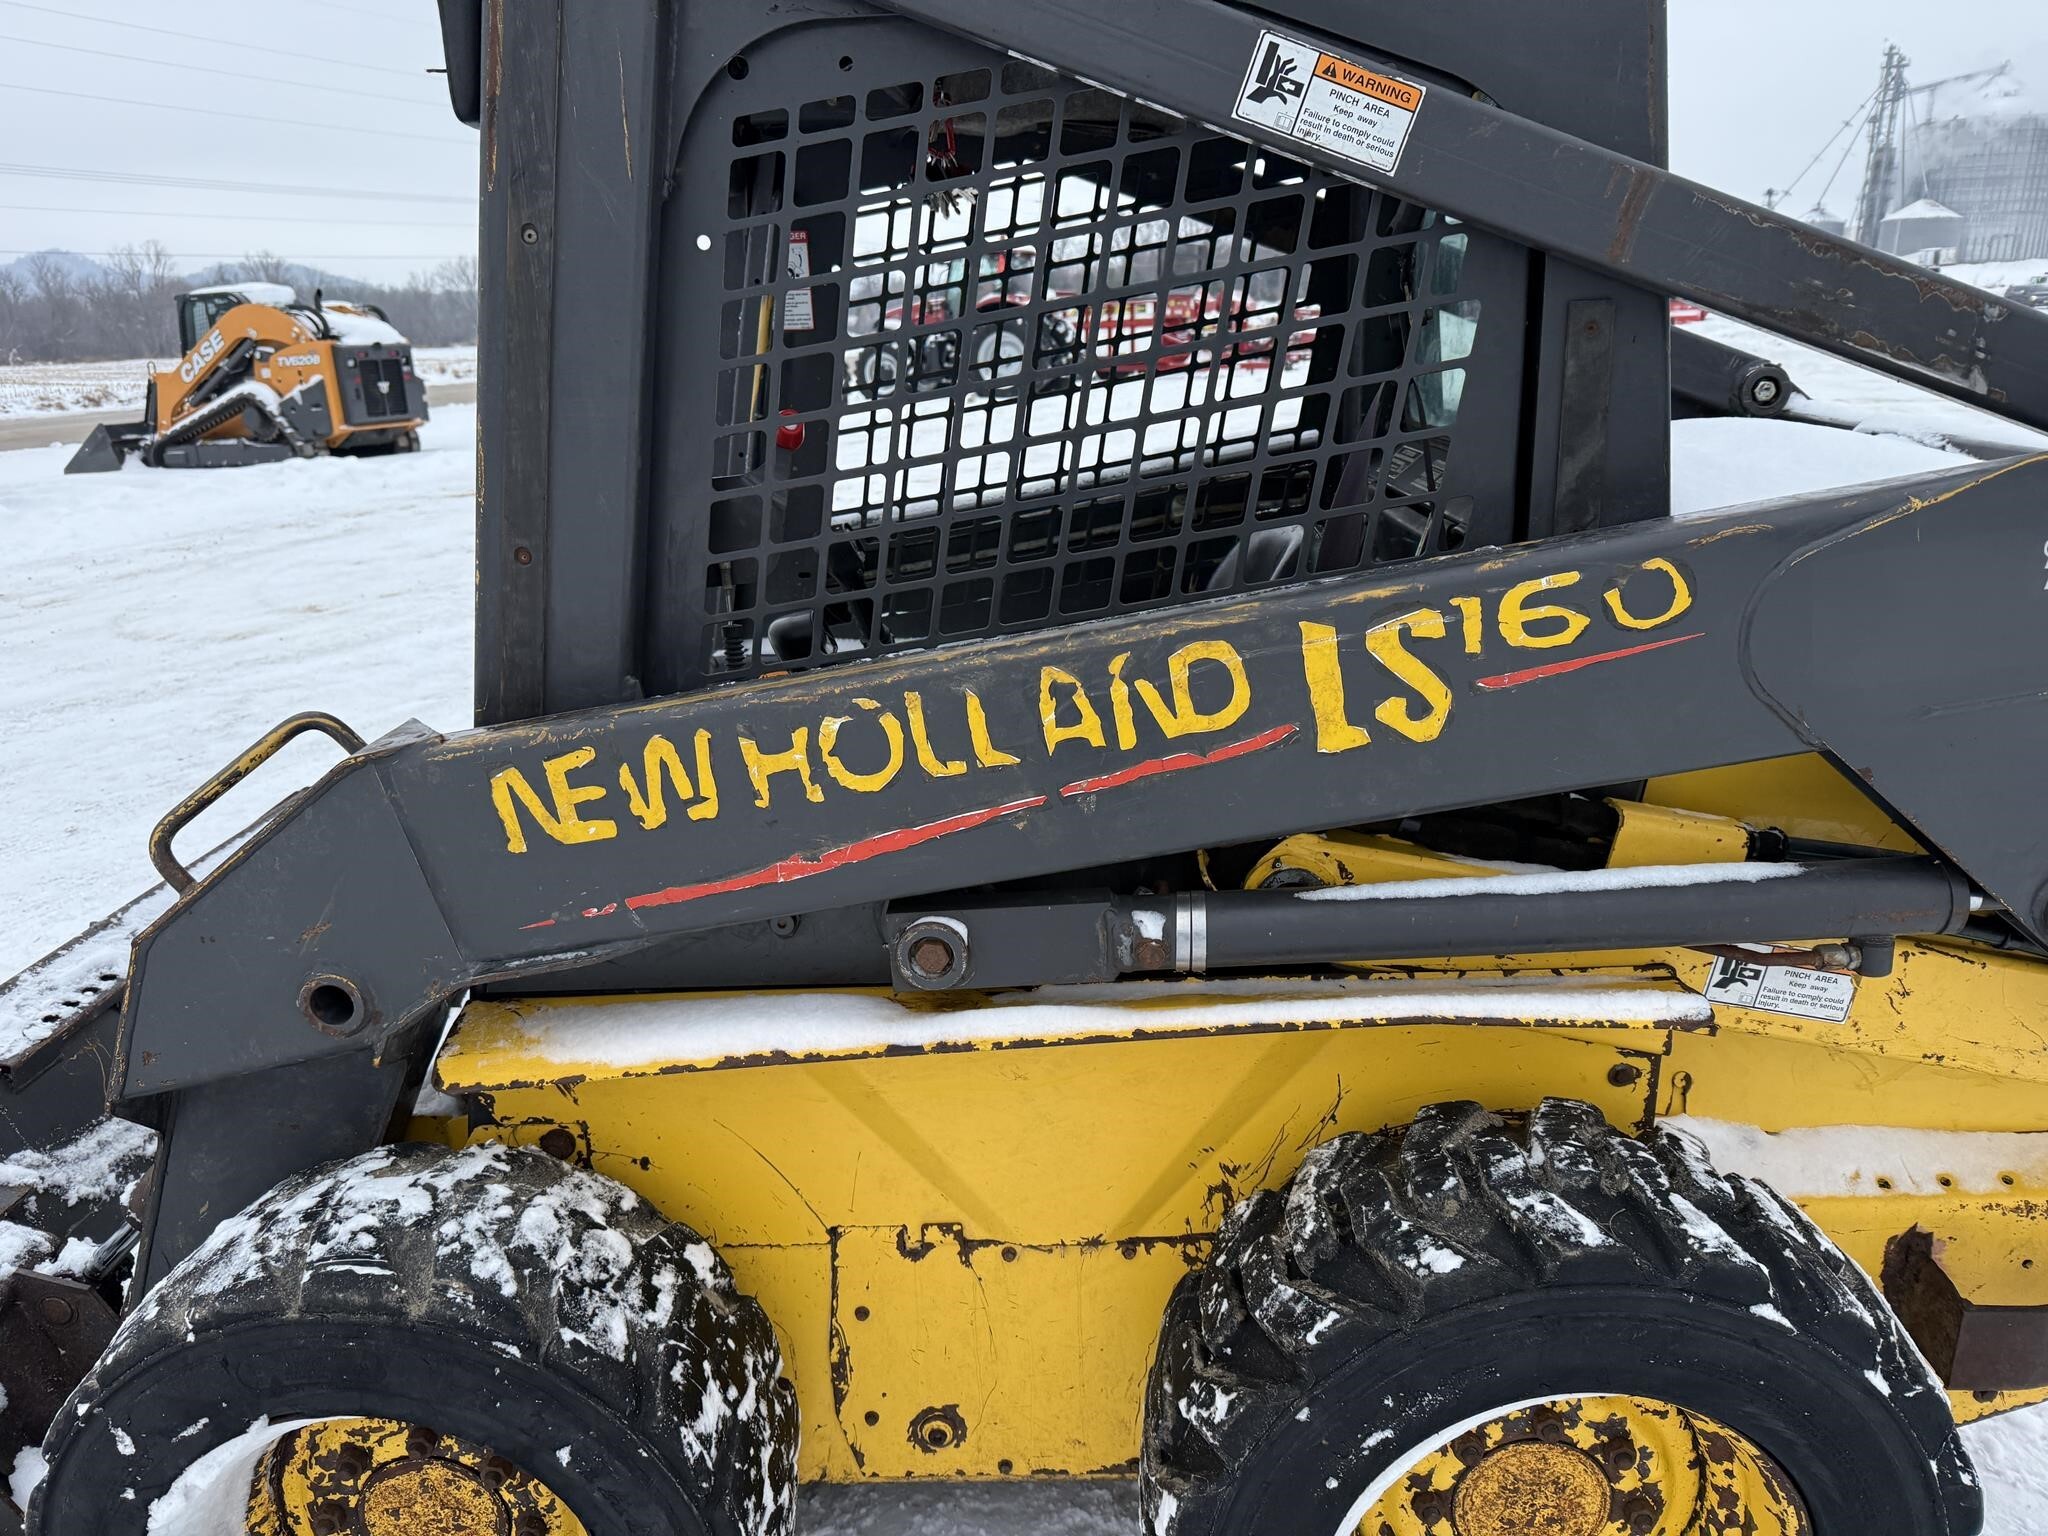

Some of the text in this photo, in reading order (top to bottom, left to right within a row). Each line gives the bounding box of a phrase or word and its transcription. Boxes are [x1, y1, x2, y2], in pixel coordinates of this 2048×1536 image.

[1342, 68, 1412, 104] WARNING
[1329, 88, 1390, 118] PINCH AREA
[1303, 108, 1395, 148] Failure to comply could
[1333, 104, 1378, 128] Keep away
[1296, 126, 1321, 142] injury.
[1300, 118, 1394, 158] result in death or serious
[180, 328, 225, 384] CASE
[491, 728, 719, 854] NEW
[738, 639, 1251, 808] HOLLAND
[1784, 970, 1838, 984] PINCH AREA
[1788, 980, 1828, 993] Keep away
[1758, 1000, 1780, 1009] injury.
[1762, 986, 1787, 995] Failure
[1797, 992, 1824, 1003] comply
[1824, 997, 1844, 1005] could
[1790, 998, 1809, 1006] death
[1818, 1002, 1844, 1012] serious
